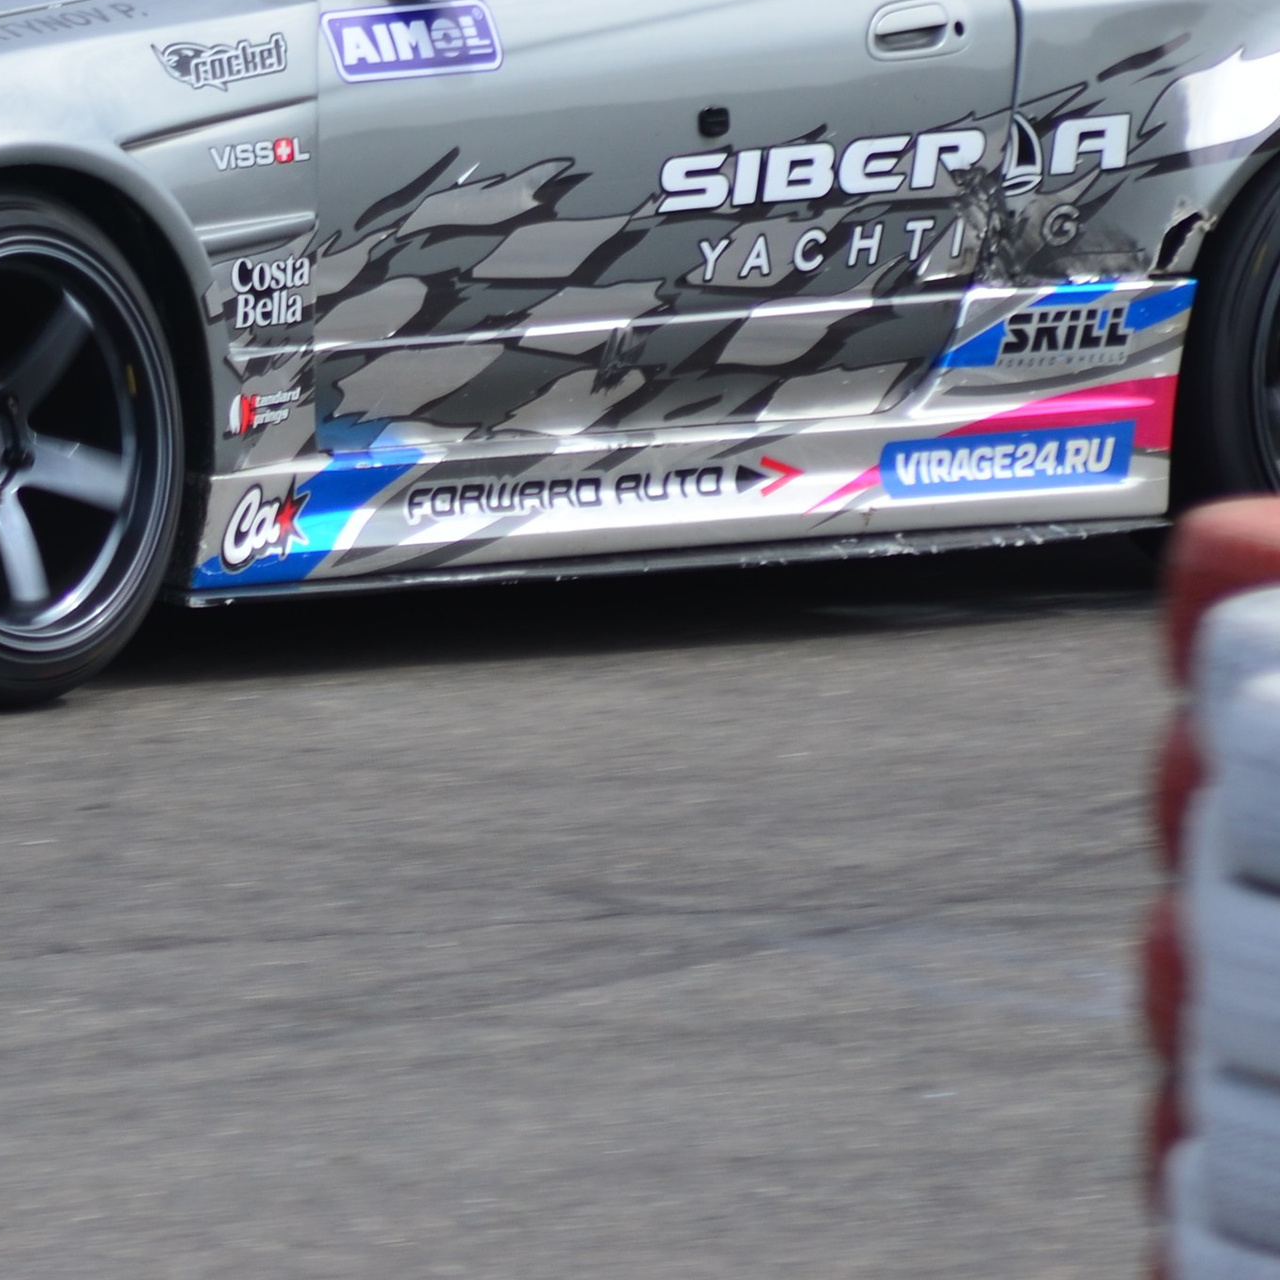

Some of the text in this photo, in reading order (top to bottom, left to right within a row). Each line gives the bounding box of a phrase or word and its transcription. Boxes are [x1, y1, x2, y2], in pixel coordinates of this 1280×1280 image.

[342, 14, 493, 66] AIMOL
[699, 204, 1080, 283] YACHTIG
[232, 254, 310, 293] Costa
[235, 291, 303, 328] Bella
[1002, 307, 1129, 354] SKILL
[895, 436, 1116, 486] VIRAGE24.RU
[409, 466, 724, 519] FORWARD AUTO
